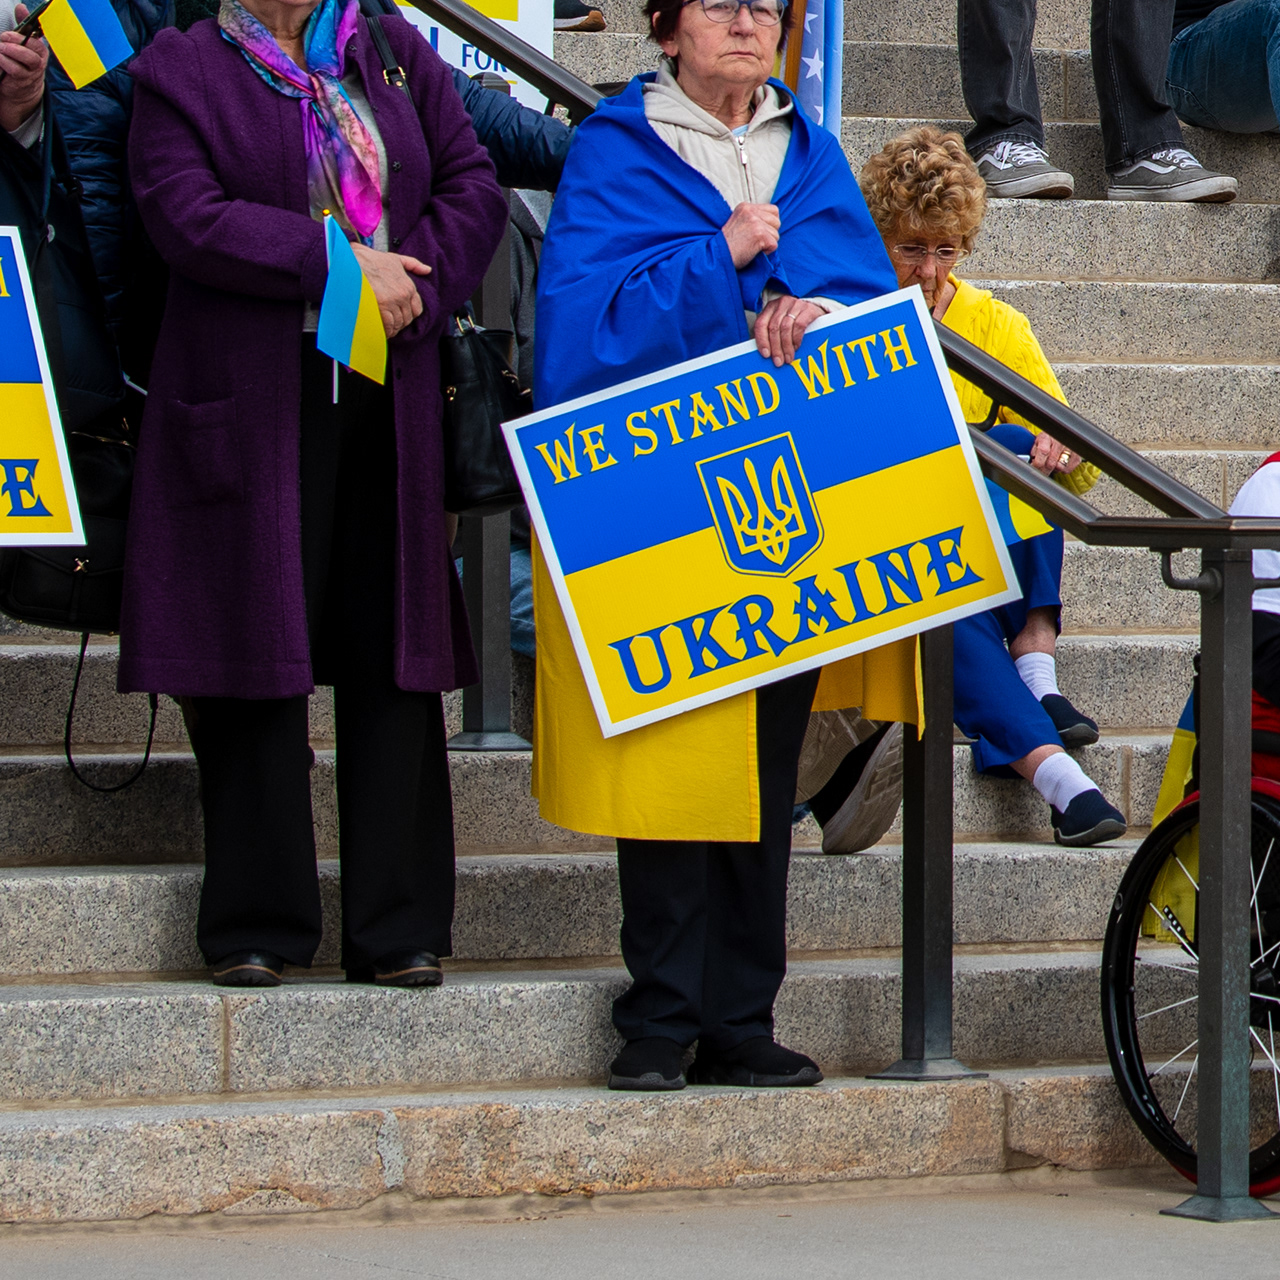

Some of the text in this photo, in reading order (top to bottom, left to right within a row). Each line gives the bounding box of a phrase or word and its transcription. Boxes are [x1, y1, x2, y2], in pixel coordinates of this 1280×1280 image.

[534, 324, 918, 485] WE STAND WITH
[608, 525, 985, 695] UKRAINE
